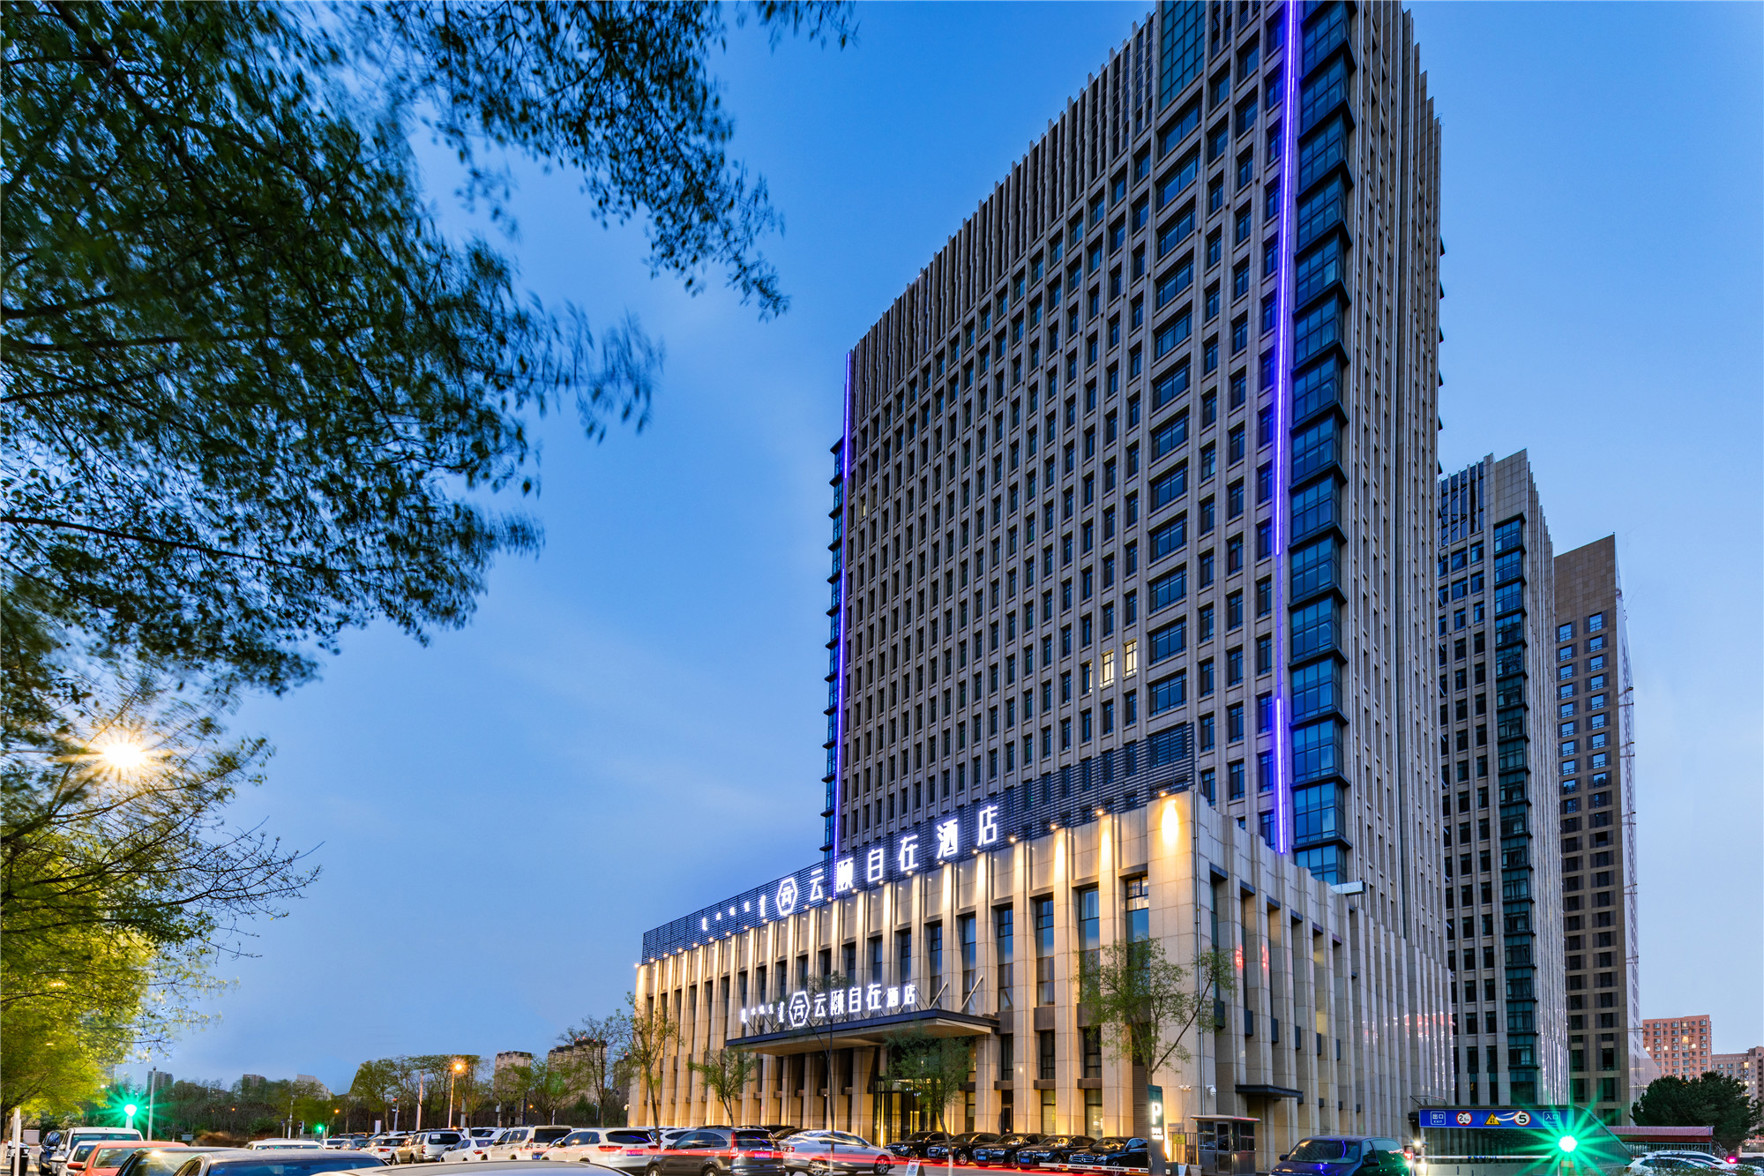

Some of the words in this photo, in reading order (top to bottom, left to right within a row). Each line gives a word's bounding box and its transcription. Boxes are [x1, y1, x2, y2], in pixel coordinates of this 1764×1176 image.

[809, 805, 999, 902] 云颐自在酒店
[814, 983, 916, 1017] 云颐自在酒店
[1151, 1102, 1163, 1125] P
[1518, 1114, 1527, 1123] 5
